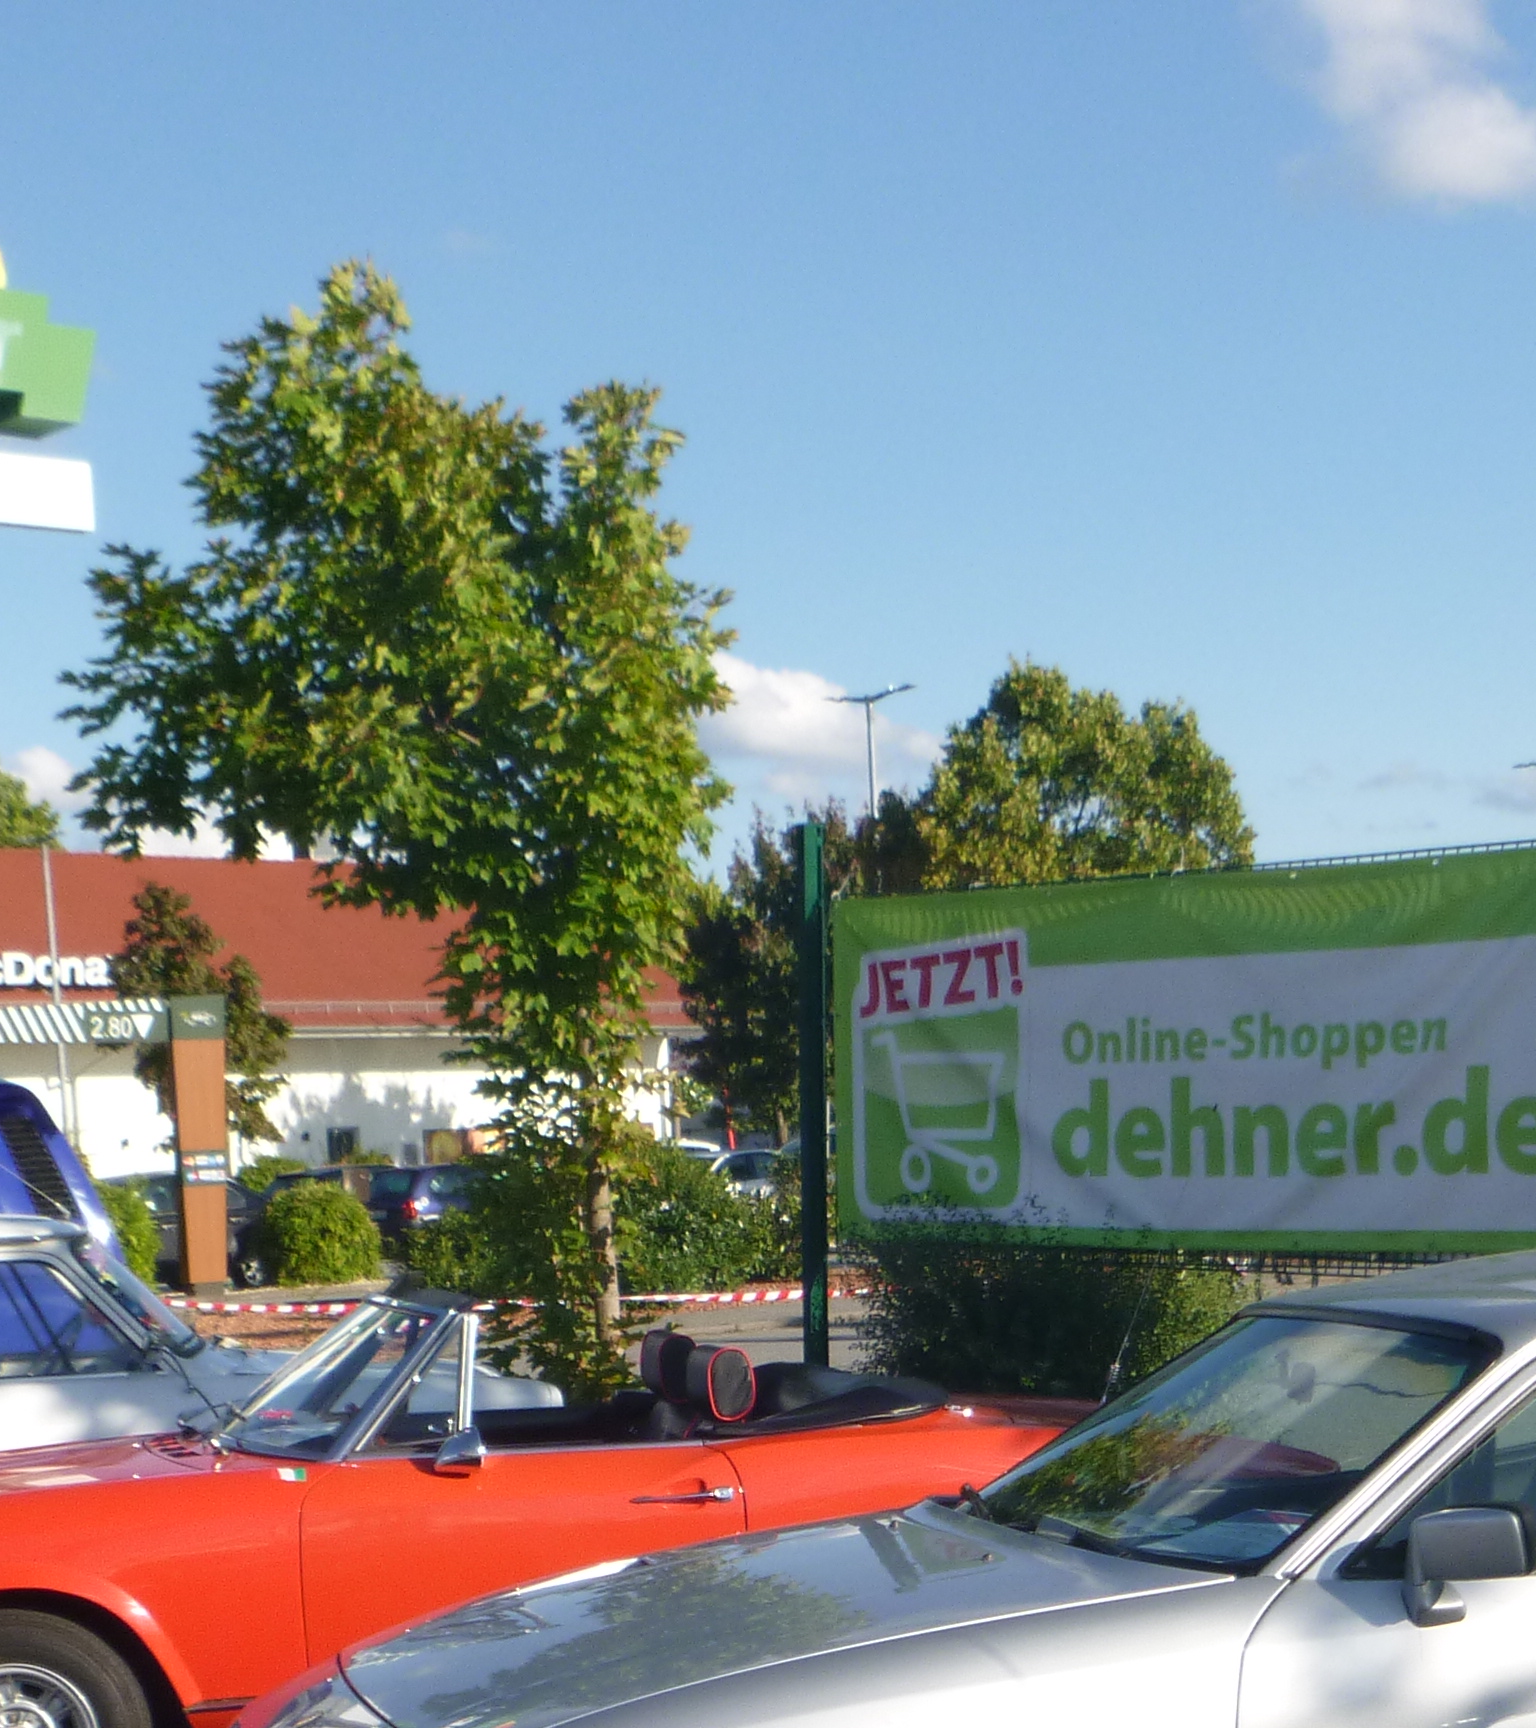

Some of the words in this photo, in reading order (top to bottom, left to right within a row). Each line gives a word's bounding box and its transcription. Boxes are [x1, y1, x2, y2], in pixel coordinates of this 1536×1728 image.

[860, 940, 1023, 1018] JETZT!
[90, 1014, 133, 1040] 2.80
[1063, 1011, 1448, 1070] Online-Shoppen
